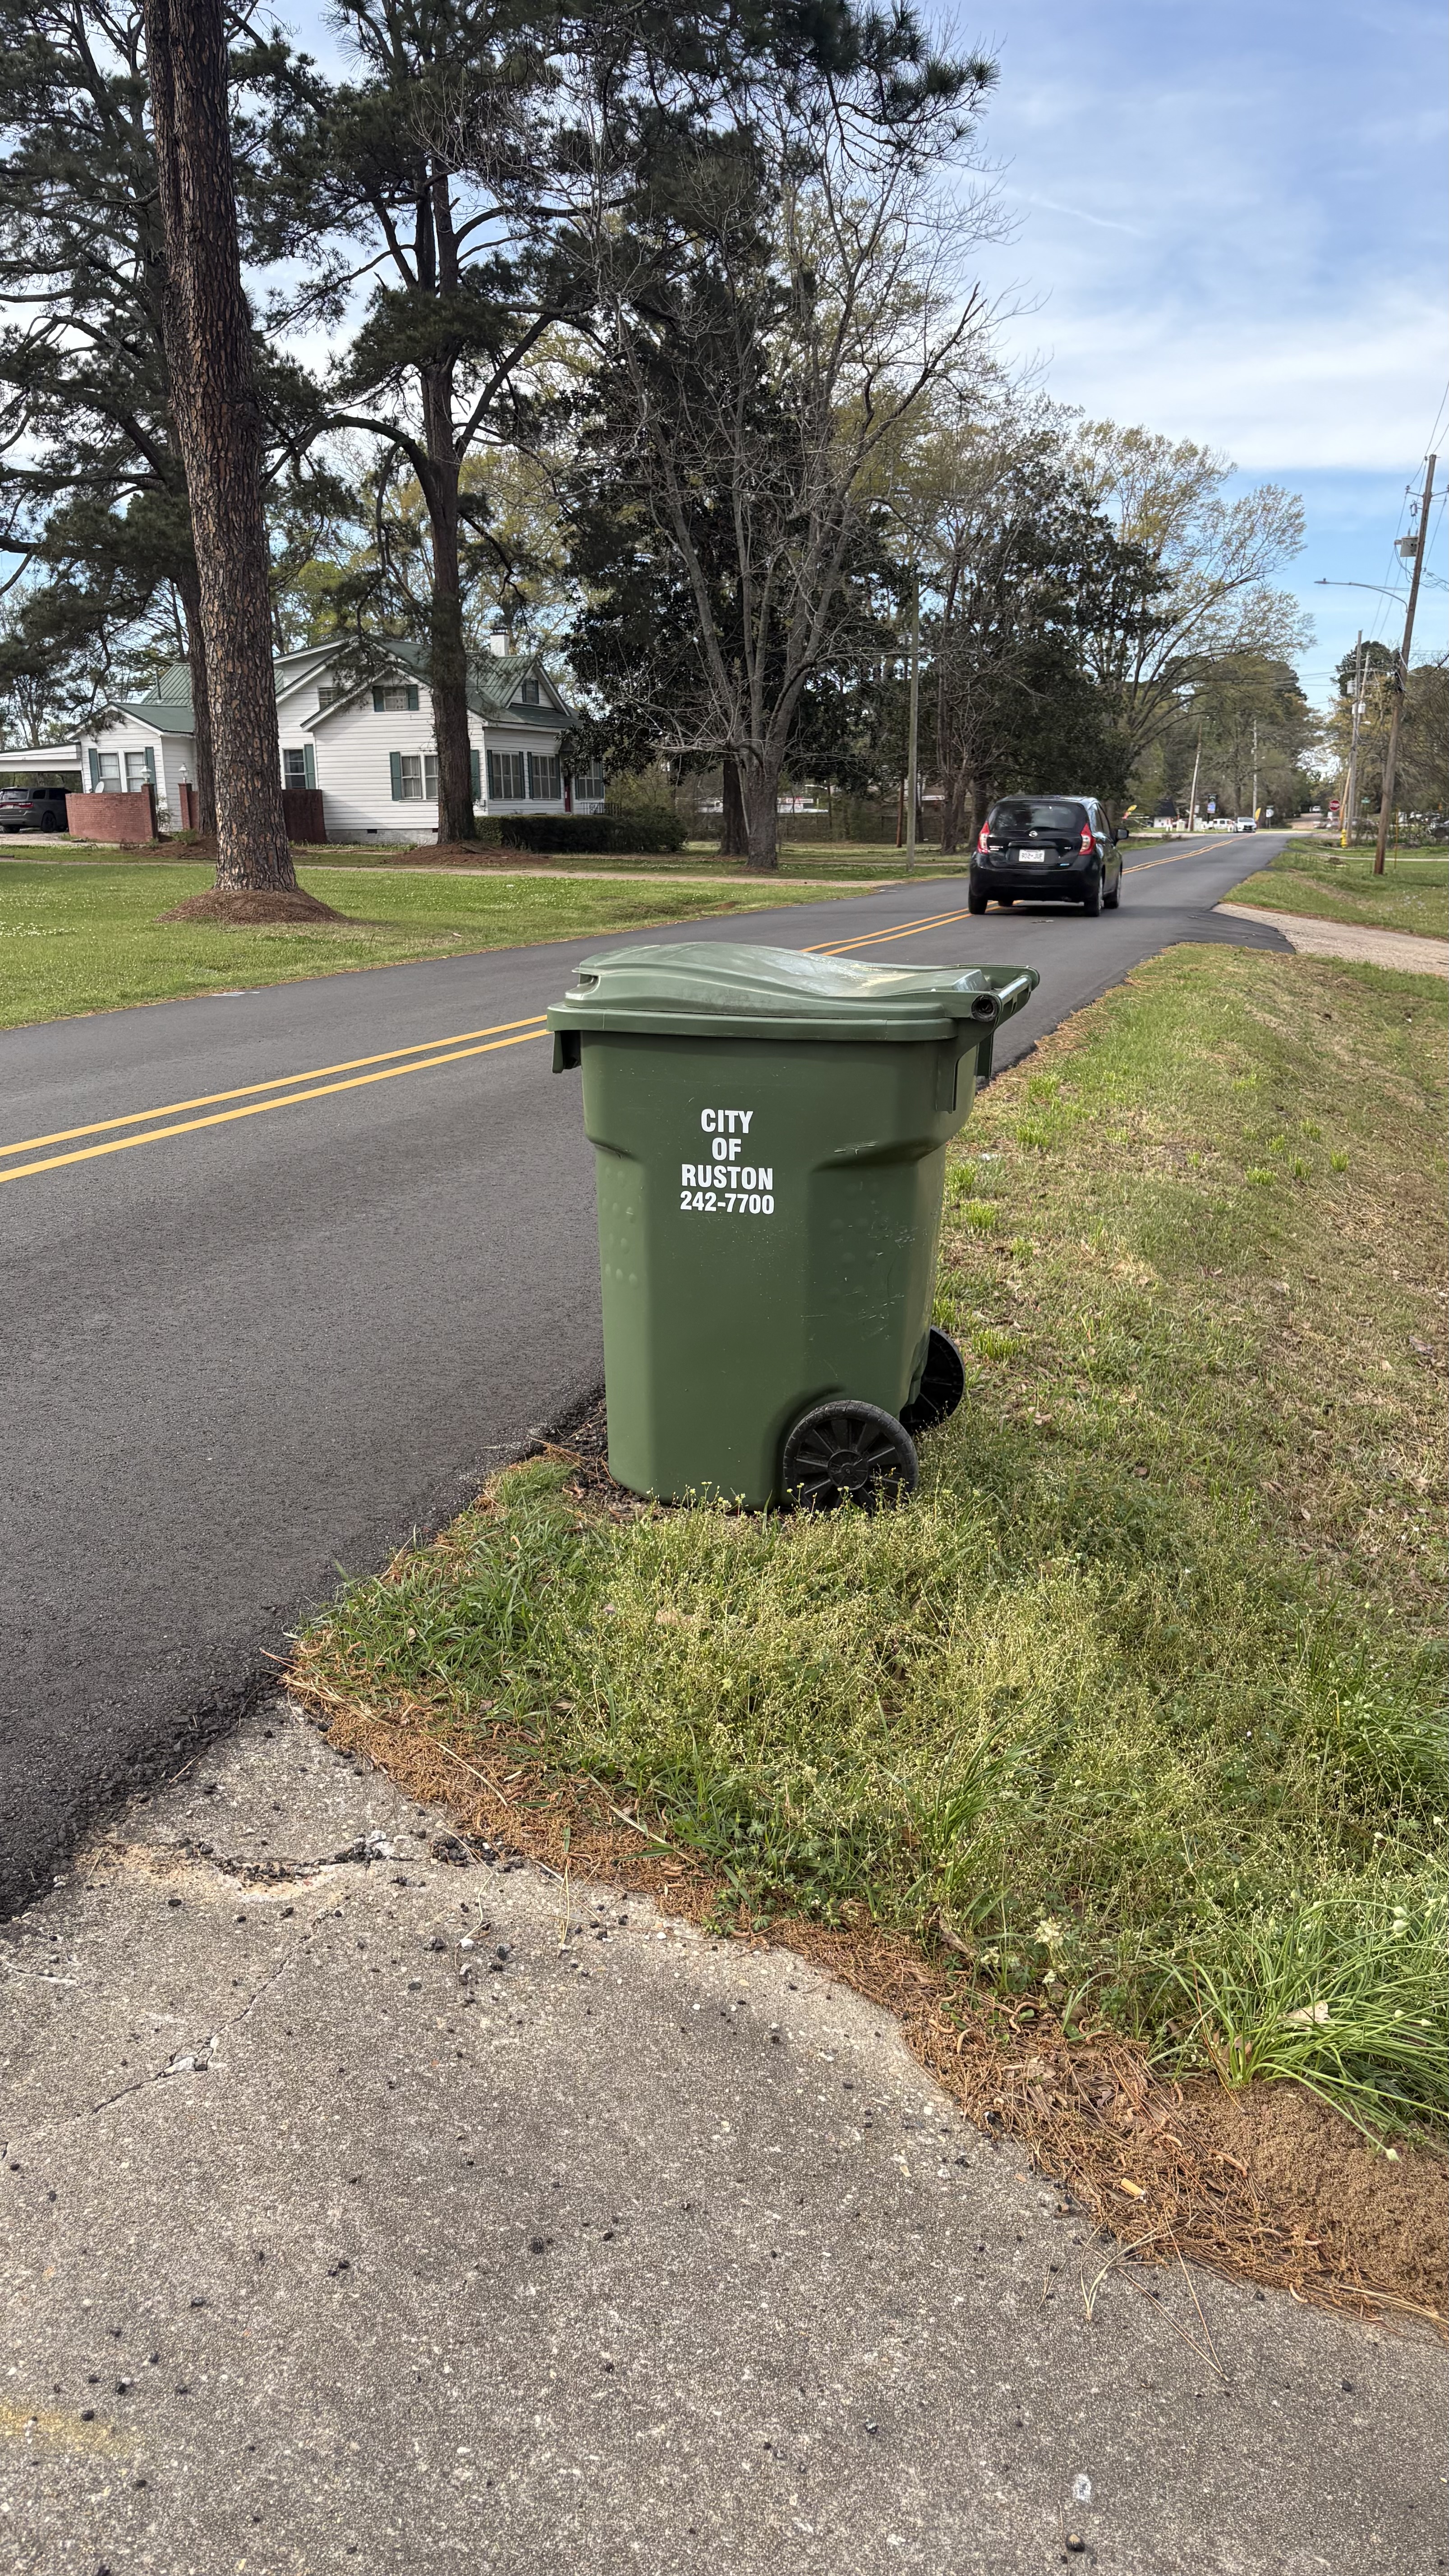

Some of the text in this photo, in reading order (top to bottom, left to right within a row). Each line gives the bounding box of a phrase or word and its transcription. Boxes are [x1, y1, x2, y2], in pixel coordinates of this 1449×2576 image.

[701, 1109, 754, 1133] CITY
[712, 1137, 741, 1161] OF
[681, 1164, 773, 1190] RUSTON
[680, 1191, 774, 1214] 242-7700
